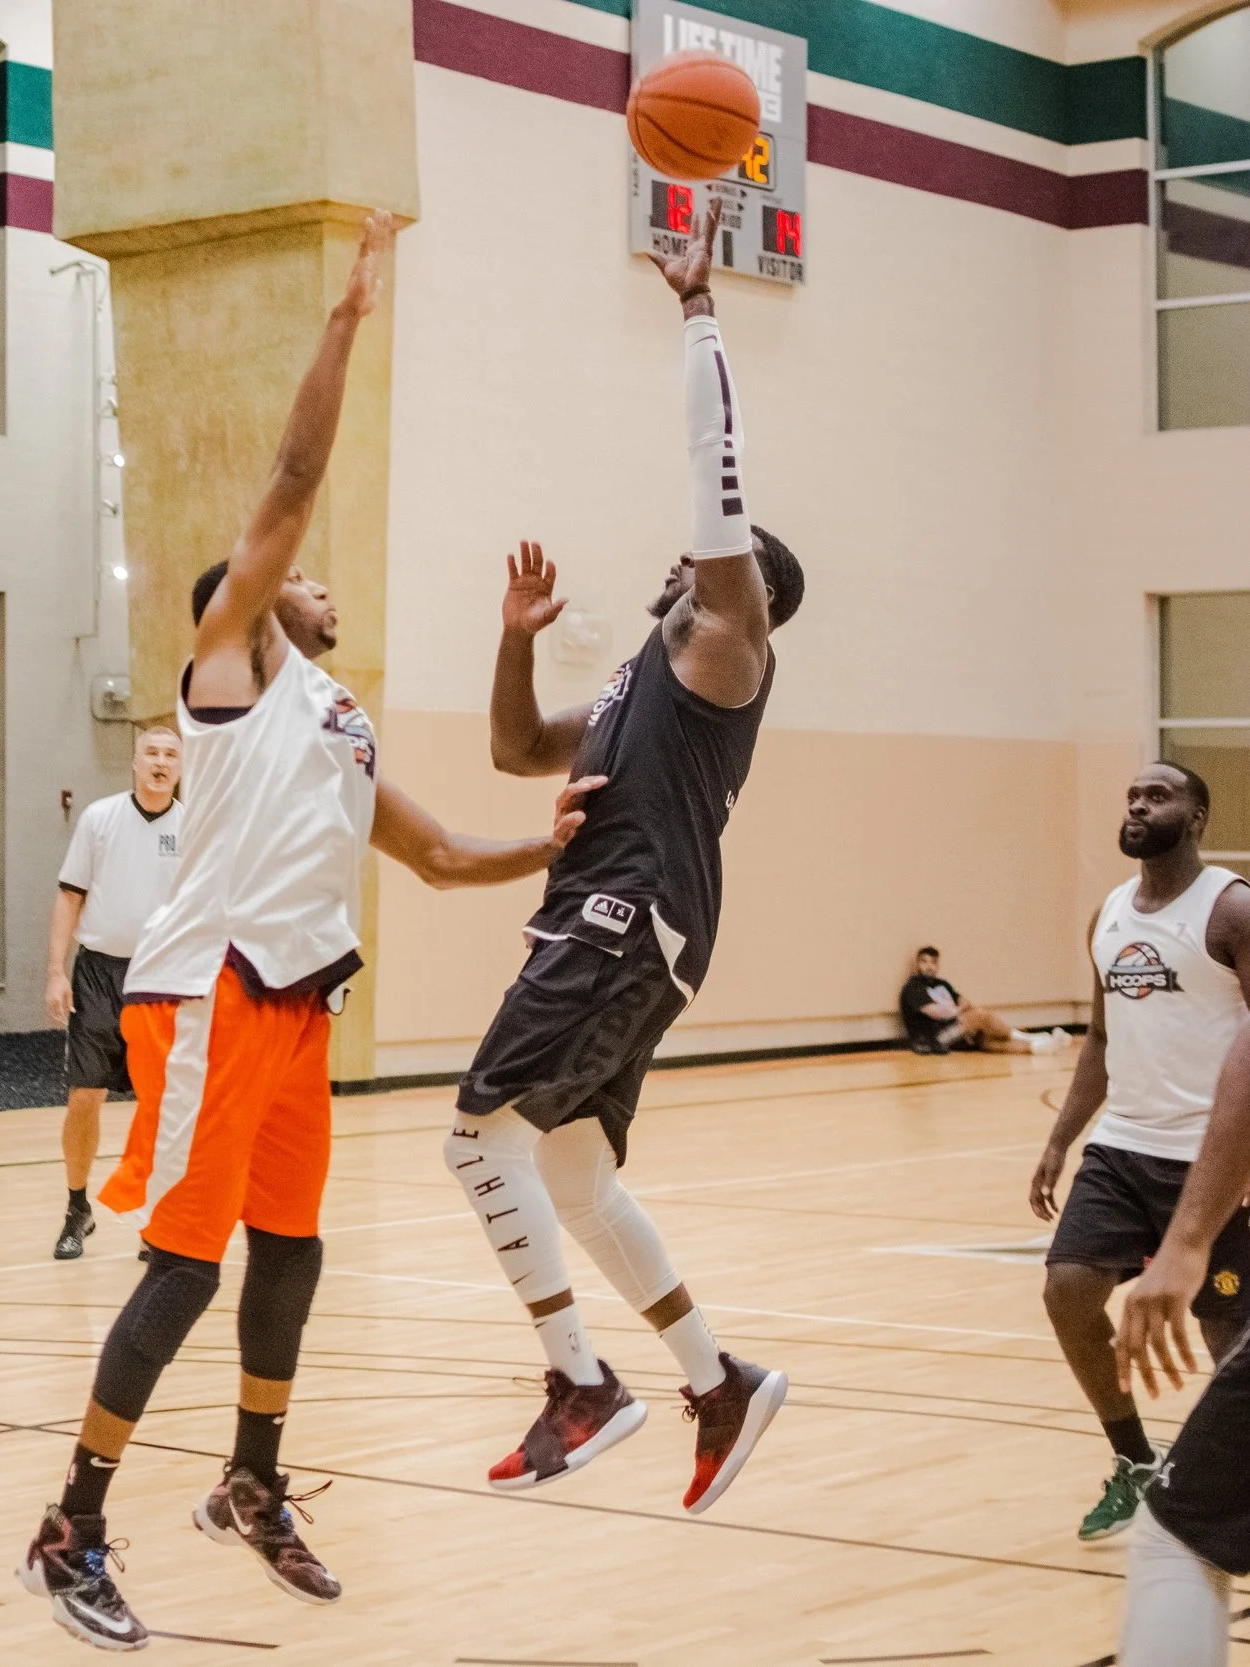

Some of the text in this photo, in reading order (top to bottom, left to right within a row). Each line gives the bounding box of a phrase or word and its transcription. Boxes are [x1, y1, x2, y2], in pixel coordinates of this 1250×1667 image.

[776, 209, 802, 257] 14
[758, 254, 804, 283] VISITOR
[1110, 973, 1167, 988] HOOPS
